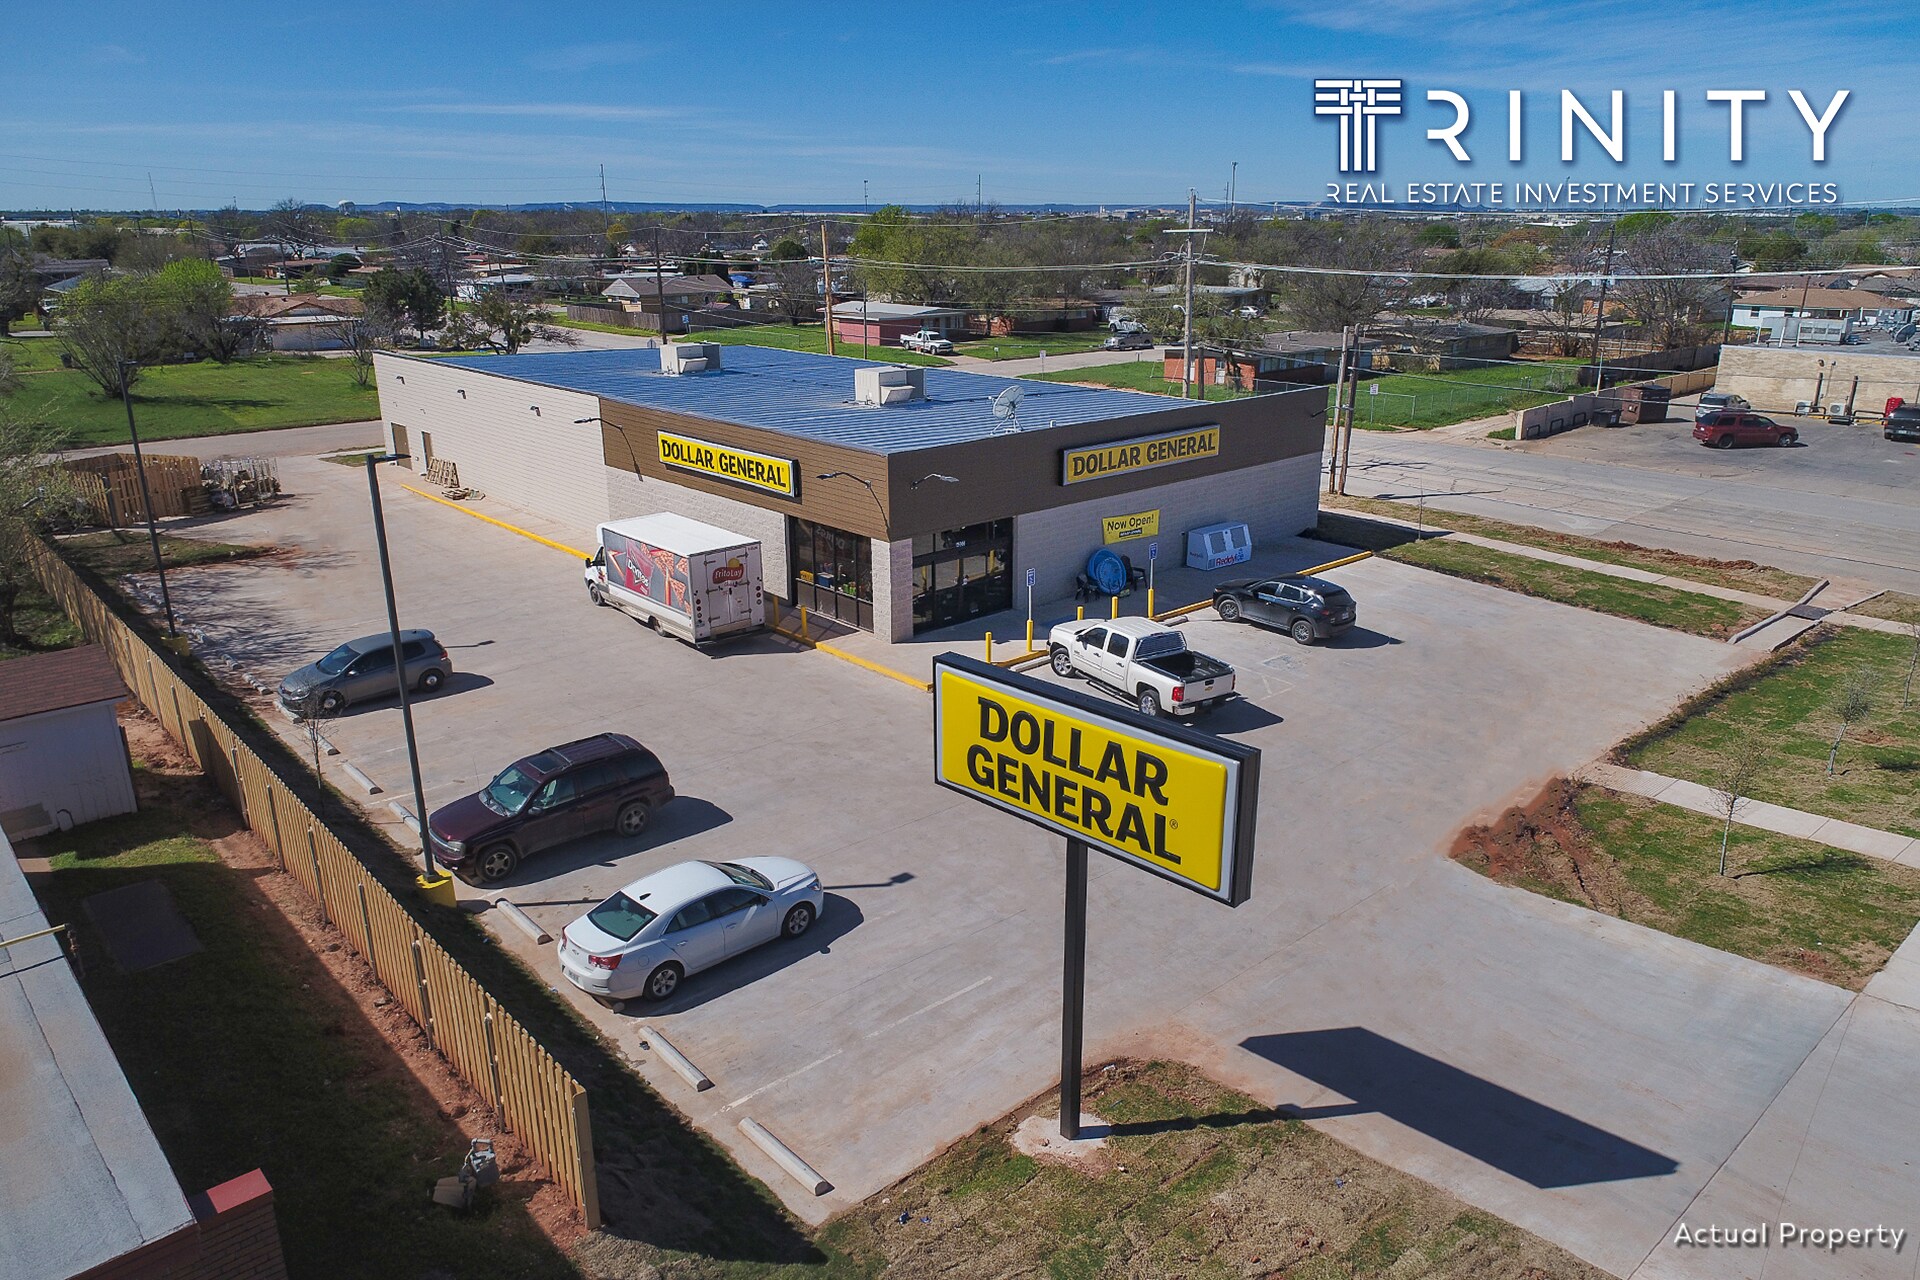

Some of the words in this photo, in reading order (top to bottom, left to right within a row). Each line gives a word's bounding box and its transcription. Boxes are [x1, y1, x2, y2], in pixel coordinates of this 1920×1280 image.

[660, 439, 715, 470] DOLLAR
[718, 452, 787, 488] GENERAL
[1072, 445, 1141, 477] DOLLAR
[1146, 433, 1216, 463] GENERAL
[1106, 520, 1127, 532] Now
[1128, 513, 1155, 528] Open!
[976, 695, 1169, 807] DOLLAR
[966, 744, 1182, 865] GENERAL
